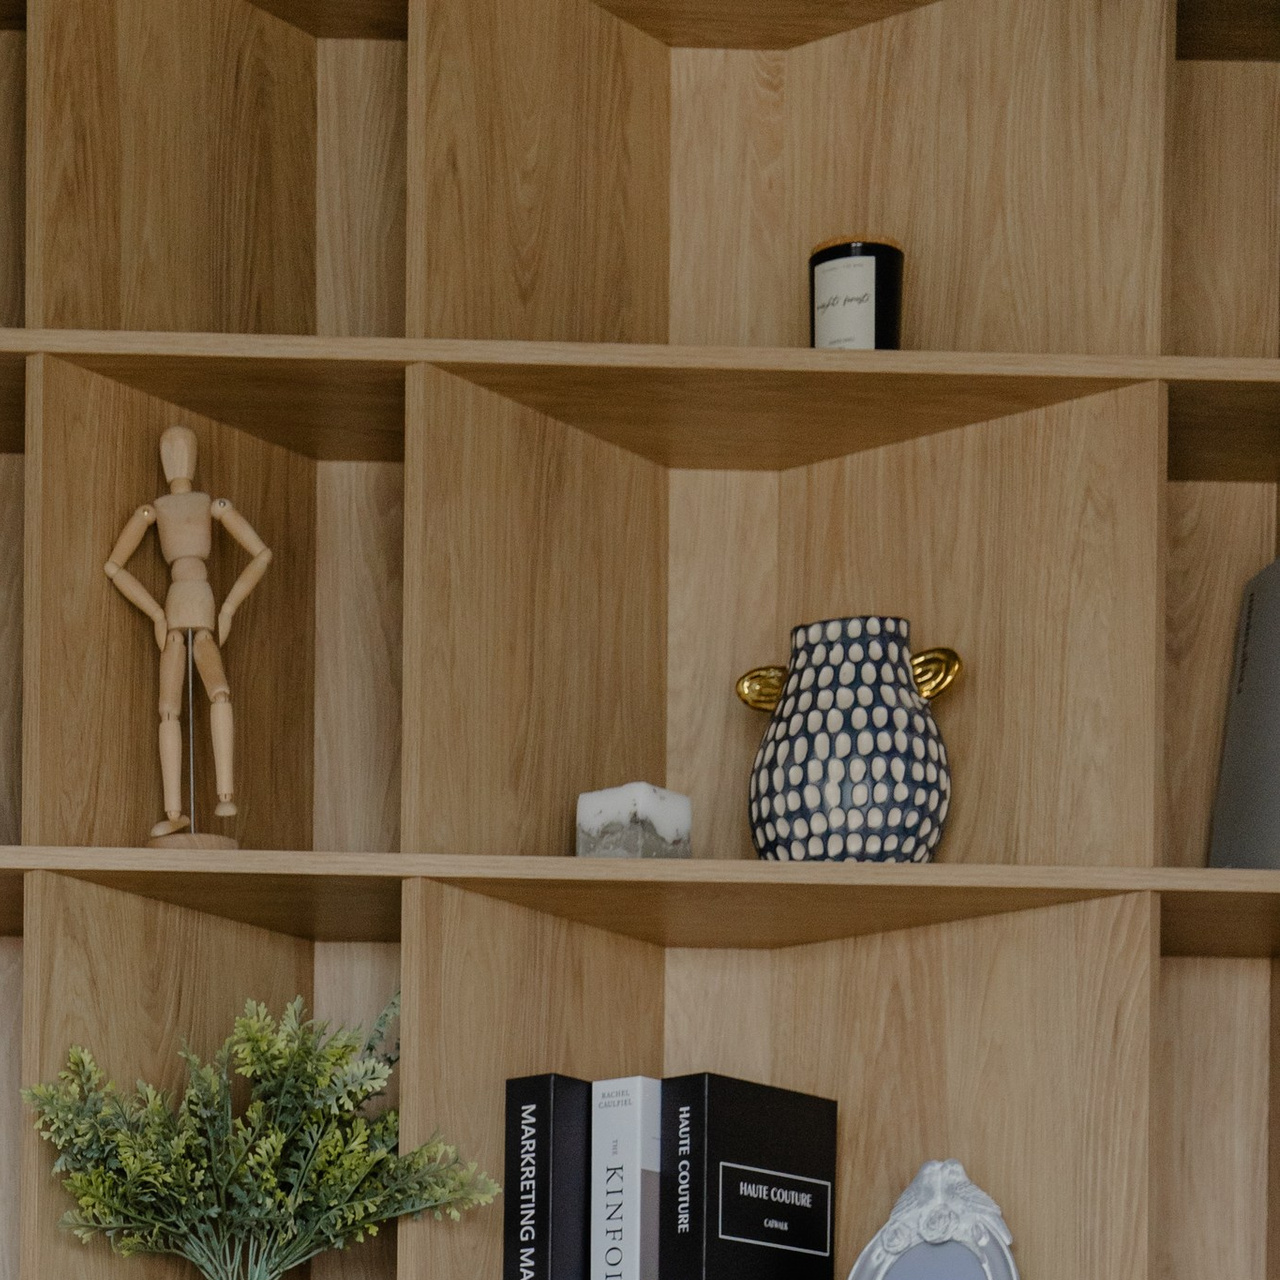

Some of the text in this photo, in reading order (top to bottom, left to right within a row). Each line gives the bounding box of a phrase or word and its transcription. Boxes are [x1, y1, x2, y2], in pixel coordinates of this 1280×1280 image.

[520, 1104, 536, 1241] MARKRETING
[677, 1106, 690, 1234] HAUTE COUTURE
[740, 1181, 812, 1208] HAUTE COUTURE
[763, 1218, 788, 1231] CATWALK
